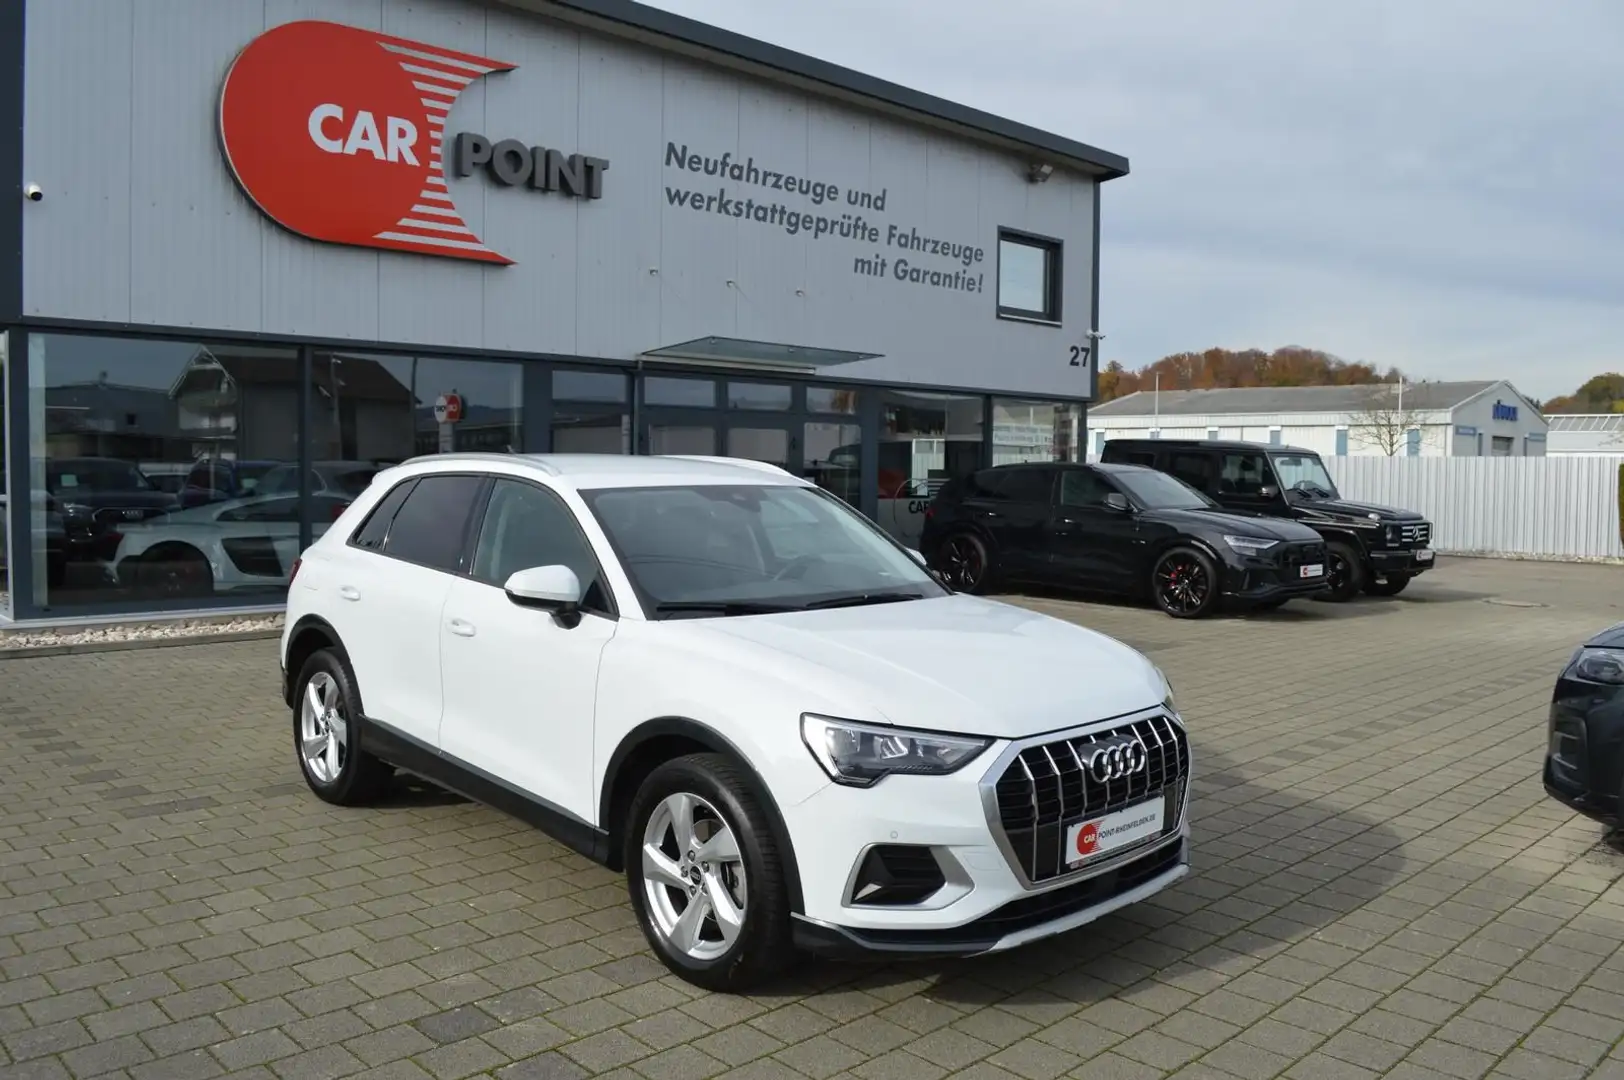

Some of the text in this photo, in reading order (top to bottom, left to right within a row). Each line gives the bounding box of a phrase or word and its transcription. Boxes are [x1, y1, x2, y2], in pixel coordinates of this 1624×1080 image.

[308, 103, 609, 200] CAR POINT
[664, 141, 887, 211] Neufahrzeuge und
[665, 186, 984, 267] werkstattgeprüfte Fahrzeuge
[854, 253, 984, 294] mit Garantie!
[1069, 345, 1090, 367] 27
[1083, 833, 1096, 844] CAR
